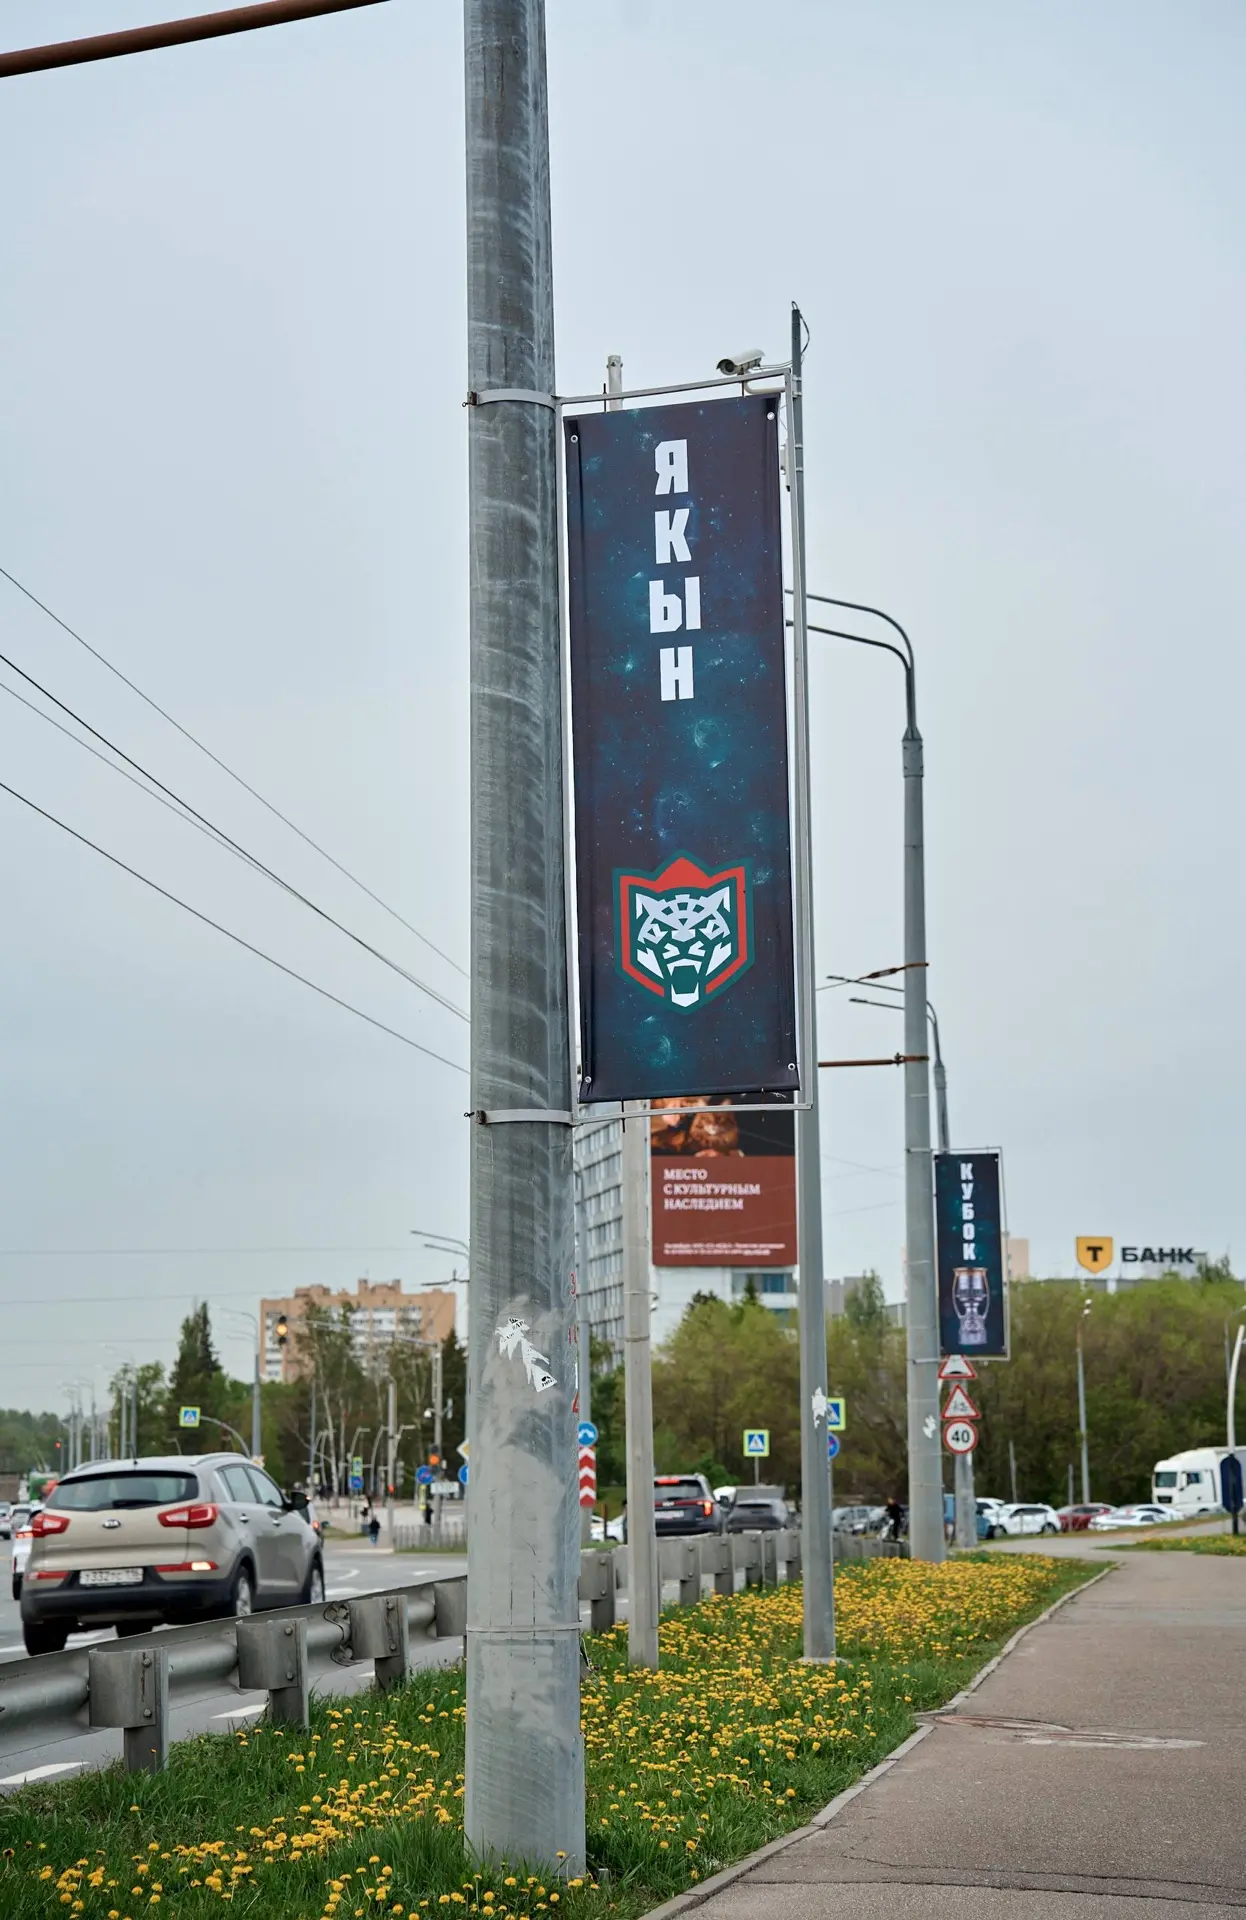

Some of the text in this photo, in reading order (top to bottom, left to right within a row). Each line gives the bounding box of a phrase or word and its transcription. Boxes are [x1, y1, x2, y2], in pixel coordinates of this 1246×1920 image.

[649, 439, 702, 702] ЯКЫН
[663, 1168, 708, 1180] МЕСТО
[663, 1183, 761, 1195] С КУЛЬТУРНЫМ
[664, 1198, 744, 1211] НАСЛЕДИЕМ
[960, 1163, 976, 1261] КУБОК
[1086, 1246, 1195, 1264] Т БАНК
[951, 1430, 970, 1444] 40
